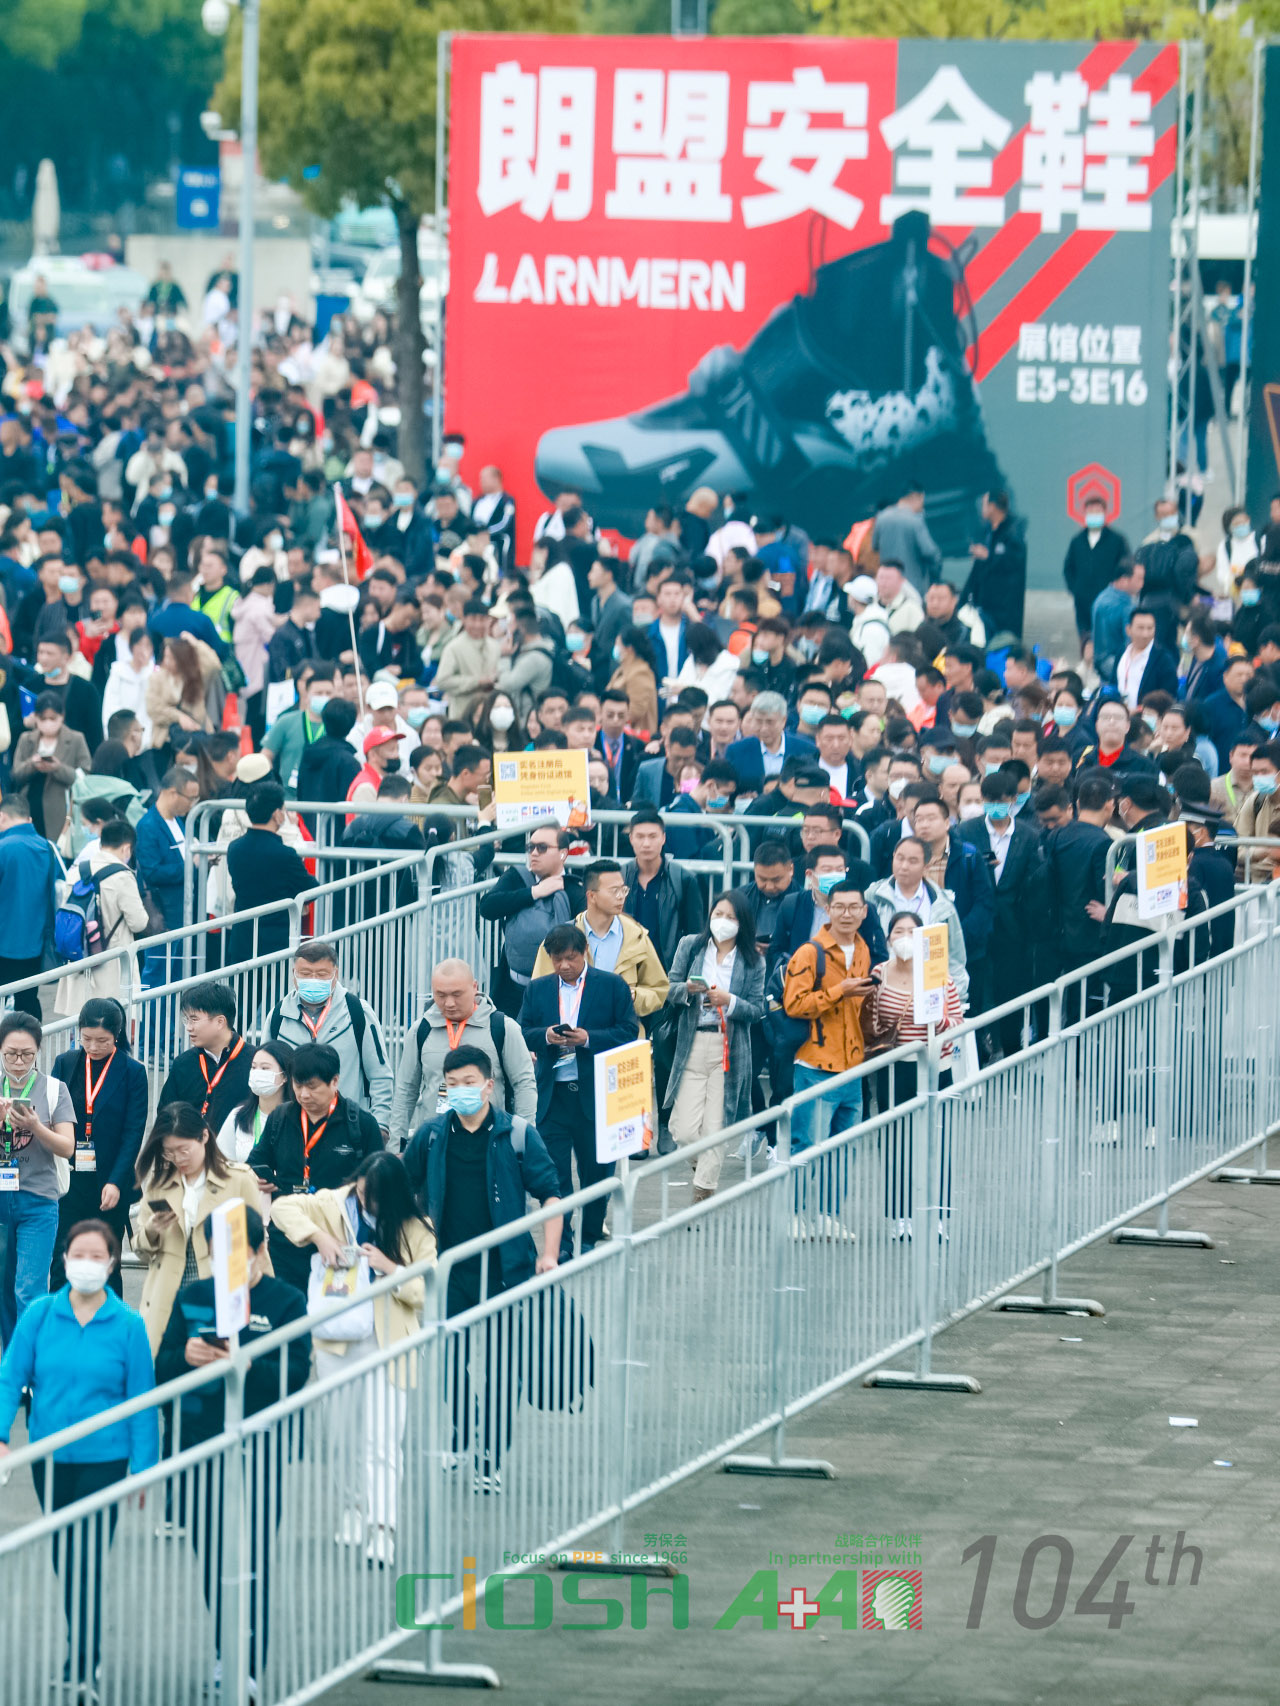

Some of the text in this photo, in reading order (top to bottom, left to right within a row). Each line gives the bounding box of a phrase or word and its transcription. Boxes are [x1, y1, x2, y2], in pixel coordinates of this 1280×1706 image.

[476, 60, 1155, 233] 朗盟安全鞋
[474, 252, 746, 312] LARNMERN
[1018, 322, 1142, 365] 展馆位置
[1017, 366, 1148, 406] E3-3E16
